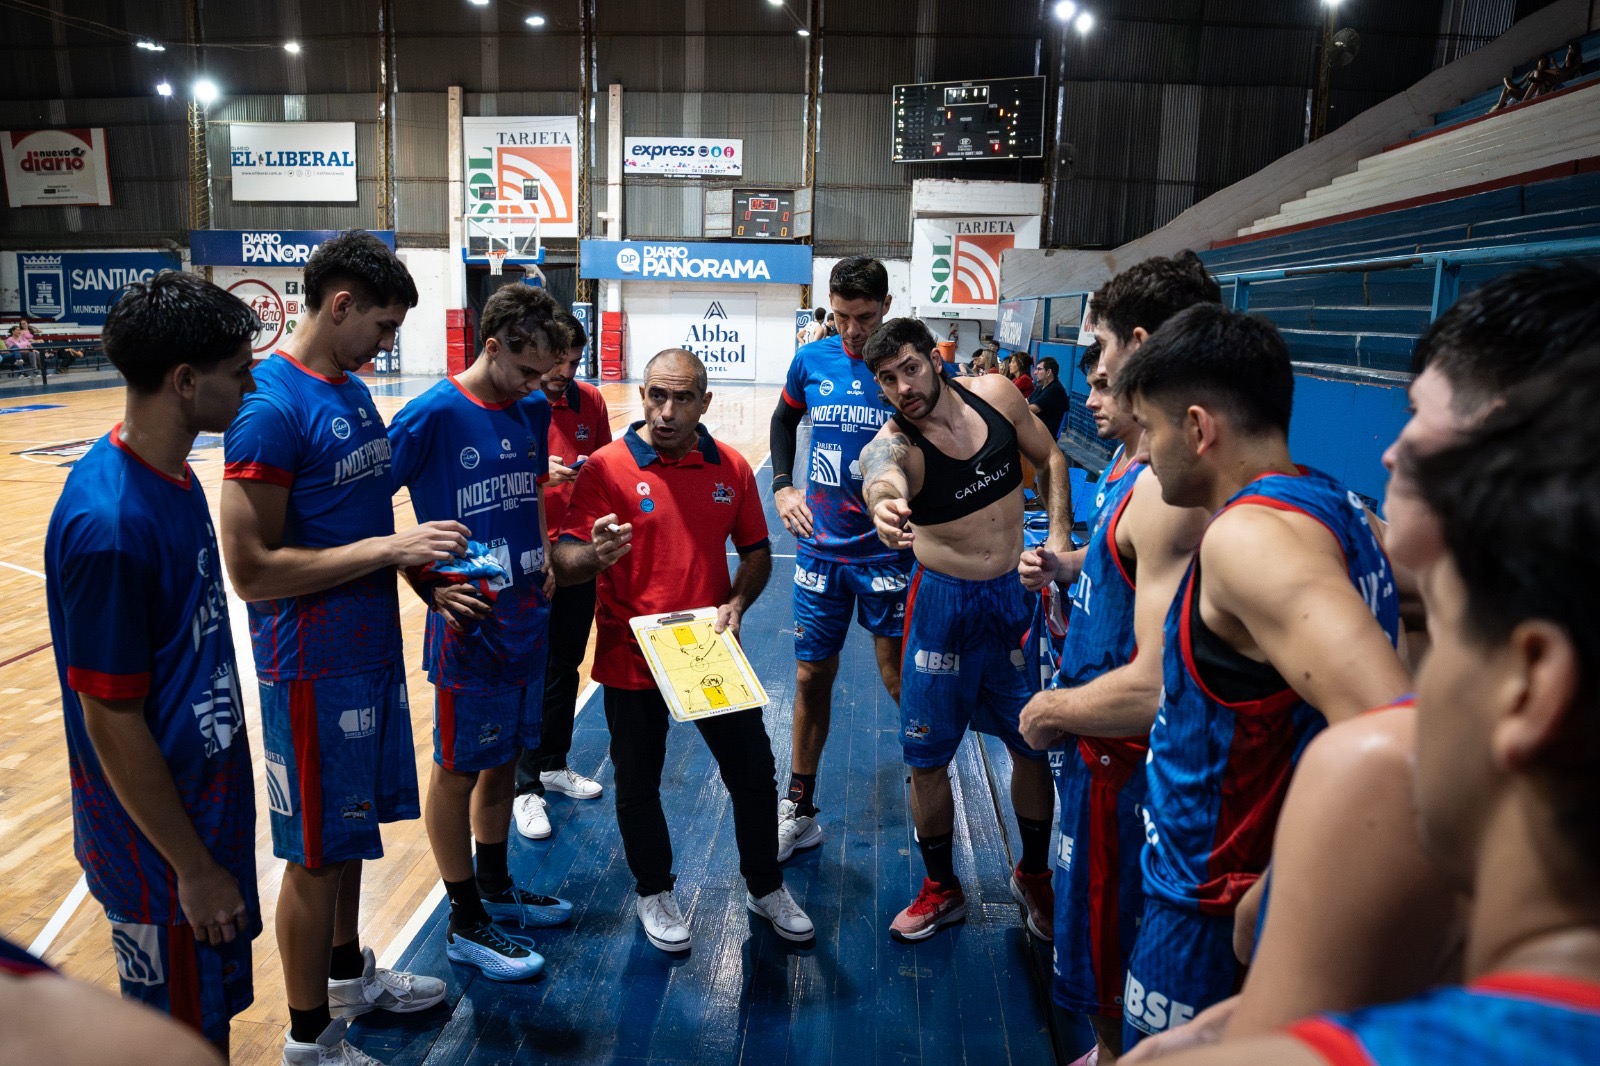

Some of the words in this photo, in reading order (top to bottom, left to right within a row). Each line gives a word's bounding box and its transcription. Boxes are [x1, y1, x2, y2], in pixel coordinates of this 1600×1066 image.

[496, 131, 572, 145] TARJETA
[39, 149, 71, 157] nuevo
[231, 151, 256, 167] EL
[265, 151, 354, 167] LIBERAL
[632, 144, 695, 160] express
[20, 151, 84, 172] diario
[955, 221, 1015, 233] TARJETA
[242, 233, 281, 245] DIARIO
[621, 254, 636, 264] DP
[643, 246, 688, 259] DIARIO
[643, 257, 771, 280] PANORAMA
[930, 235, 952, 304] SOL
[686, 323, 739, 343] Abba
[811, 404, 895, 427] INDEPENDIENT
[955, 462, 1011, 500] CATAPULT
[502, 497, 520, 512] BBC
